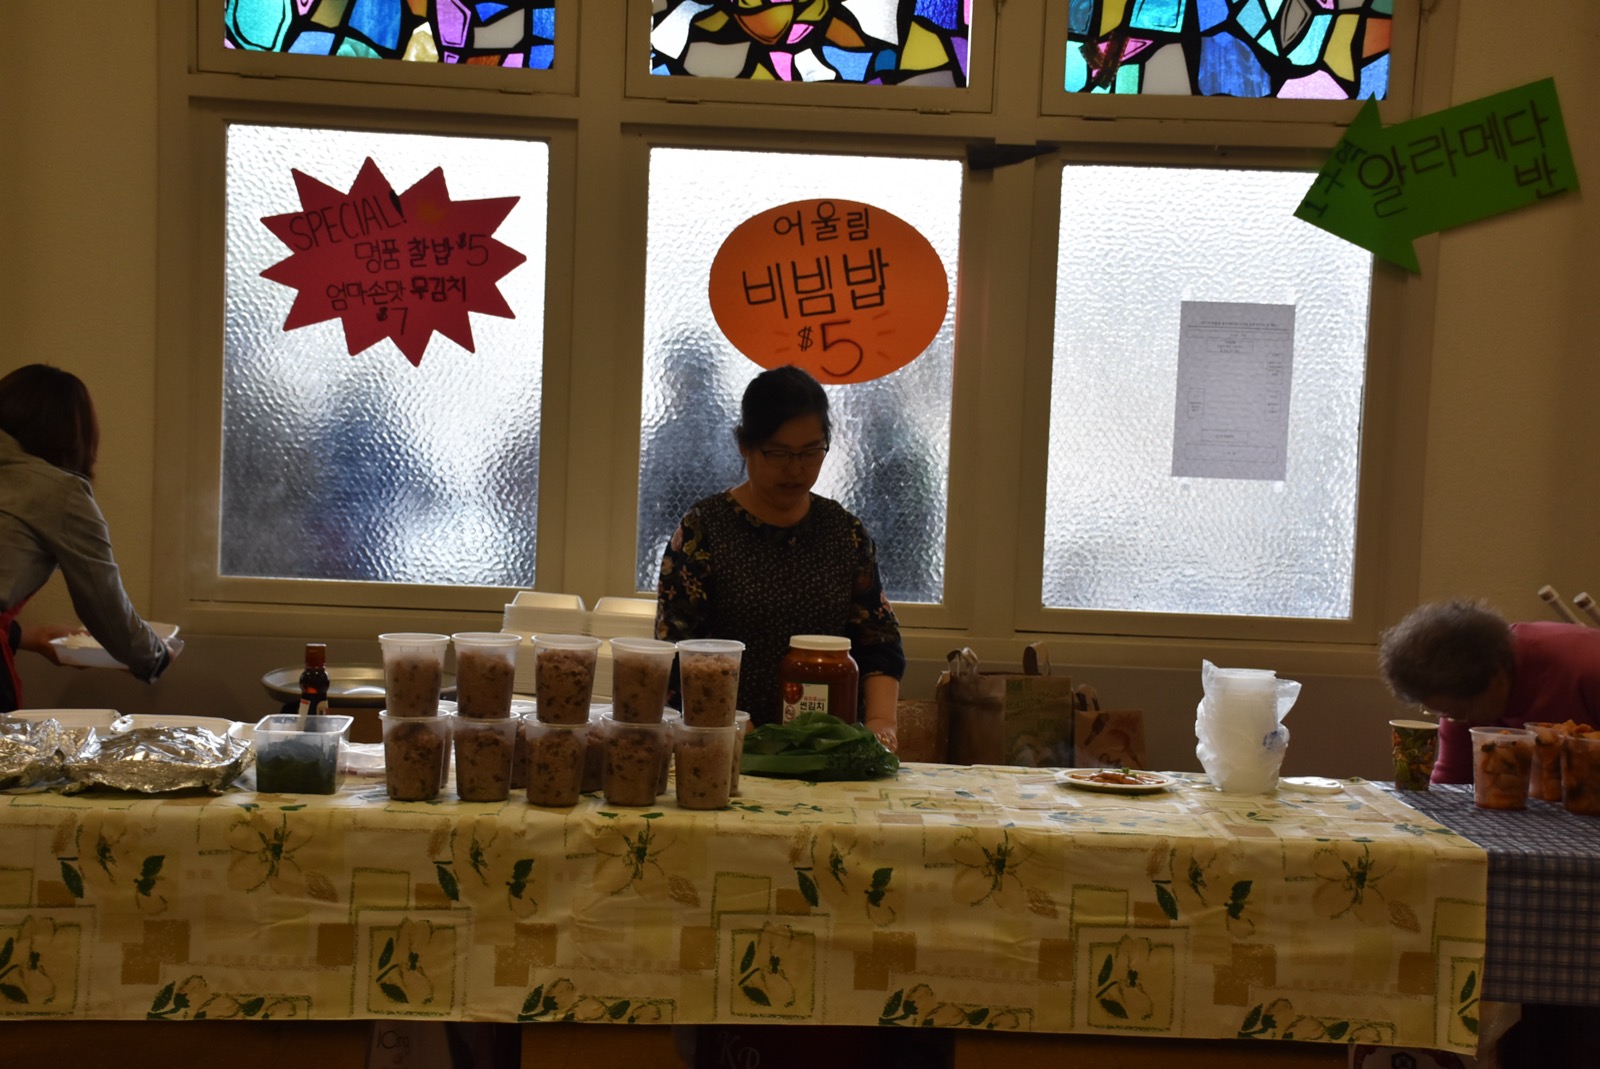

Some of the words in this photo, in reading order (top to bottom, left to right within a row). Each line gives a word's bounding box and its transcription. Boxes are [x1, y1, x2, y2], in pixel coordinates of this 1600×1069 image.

[1357, 100, 1549, 219] 알라메다
[1514, 153, 1568, 200] 반
[289, 190, 407, 251] SPECIAL!
[773, 201, 869, 246] 어울림
[355, 239, 400, 273] 명품
[408, 237, 454, 268] 찰밥
[456, 232, 489, 266] $5
[410, 275, 467, 302] 무김치
[742, 247, 890, 319] 비빔밥
[376, 306, 408, 336] $7
[797, 319, 863, 377] $5
